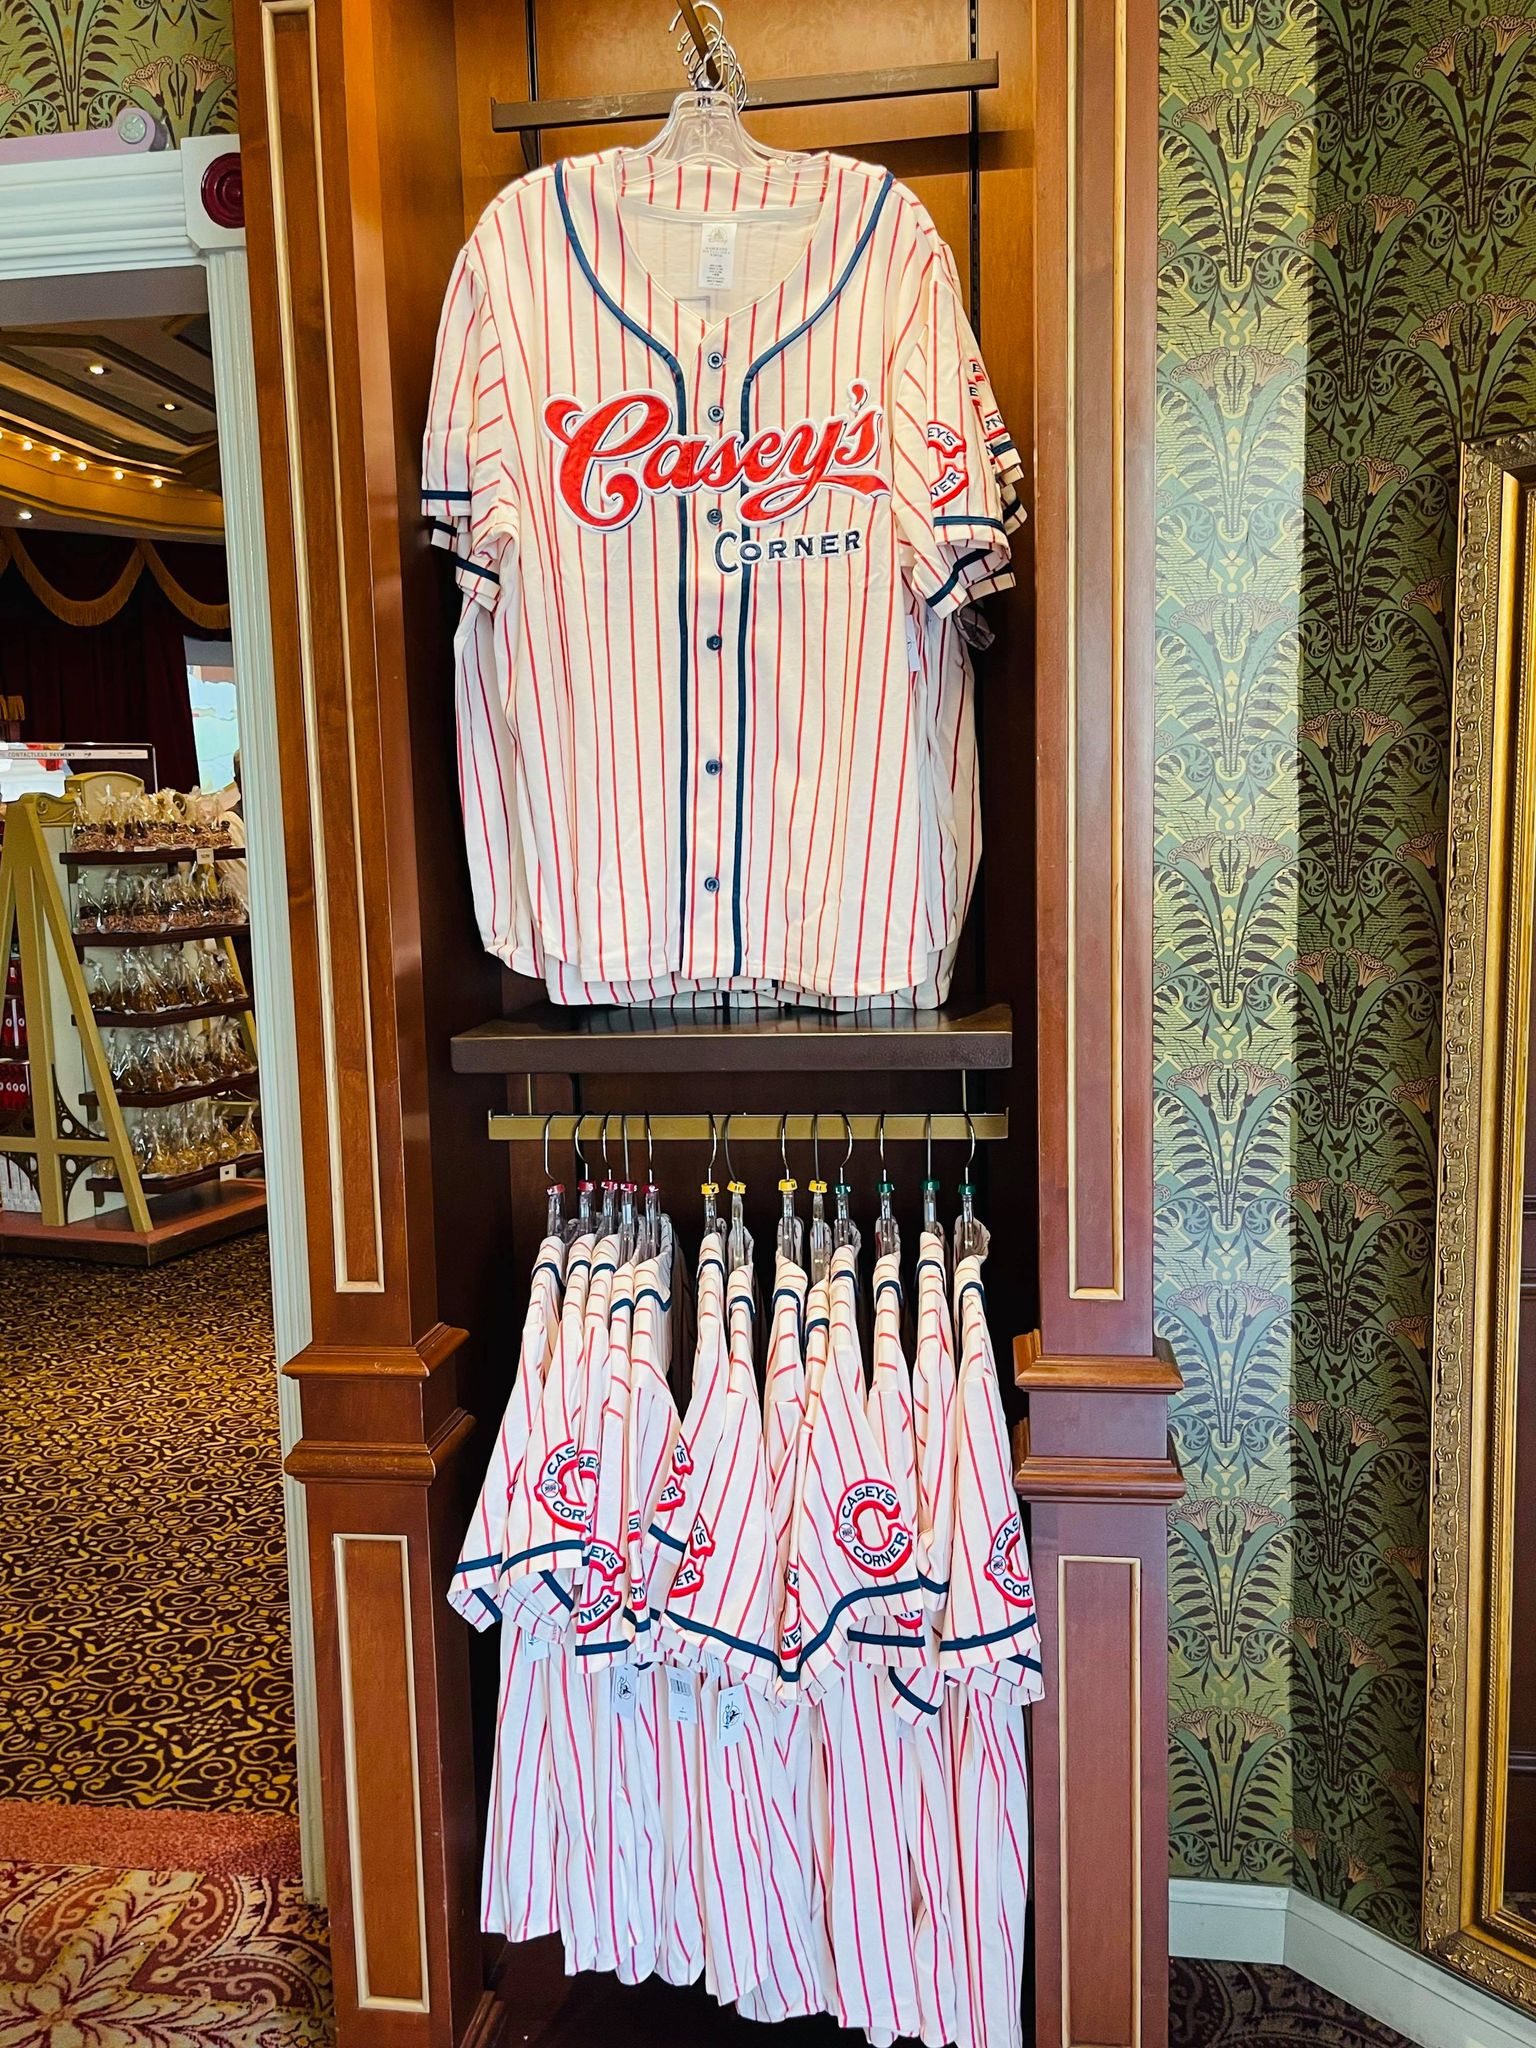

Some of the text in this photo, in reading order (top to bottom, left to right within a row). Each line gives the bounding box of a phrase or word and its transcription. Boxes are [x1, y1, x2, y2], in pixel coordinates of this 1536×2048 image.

[927, 428, 956, 447] EY'S
[543, 378, 892, 531] Casey's
[715, 529, 862, 573] CORNER
[552, 1500, 584, 1521] COR
[842, 1485, 897, 1519] CASEY'S
[590, 1546, 618, 1569] EY'S
[853, 1532, 908, 1568] CORNER
[1003, 1577, 1030, 1598] COR
[580, 1594, 615, 1624] NER
